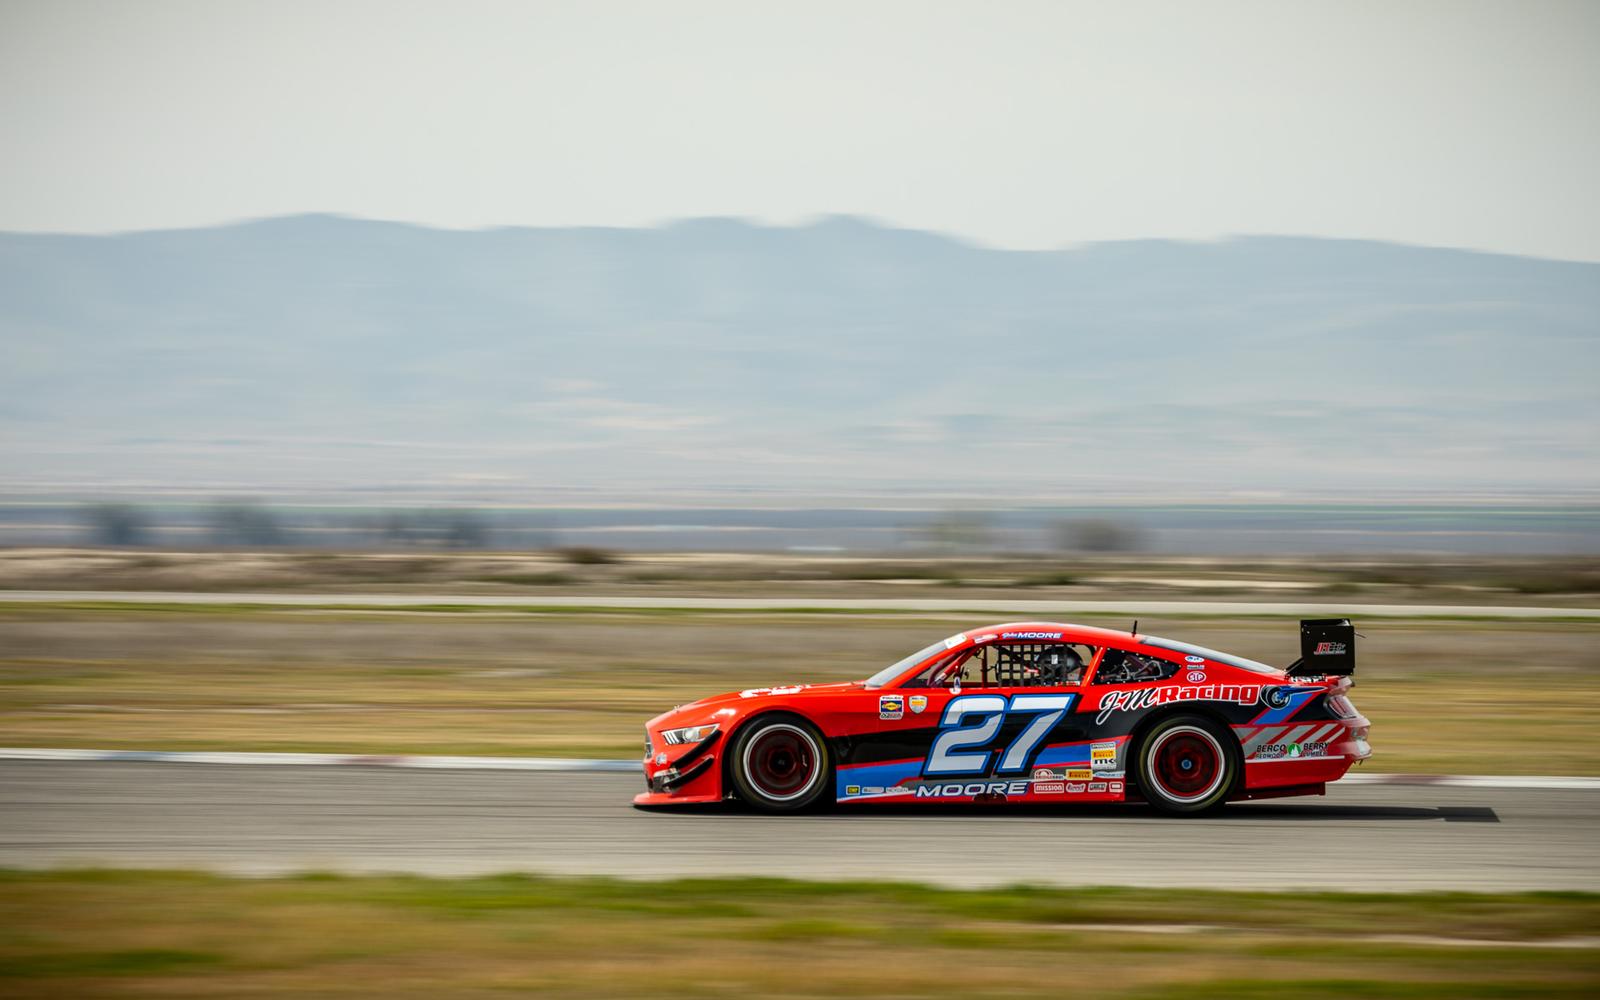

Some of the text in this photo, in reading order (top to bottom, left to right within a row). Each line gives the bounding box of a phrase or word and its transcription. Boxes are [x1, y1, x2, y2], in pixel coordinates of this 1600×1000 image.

[1018, 631, 1062, 639] MOORE
[1190, 672, 1204, 681] STP
[923, 693, 1078, 776] 27
[1256, 742, 1329, 753] BERCO BERRY
[914, 782, 1028, 797] MOORE
